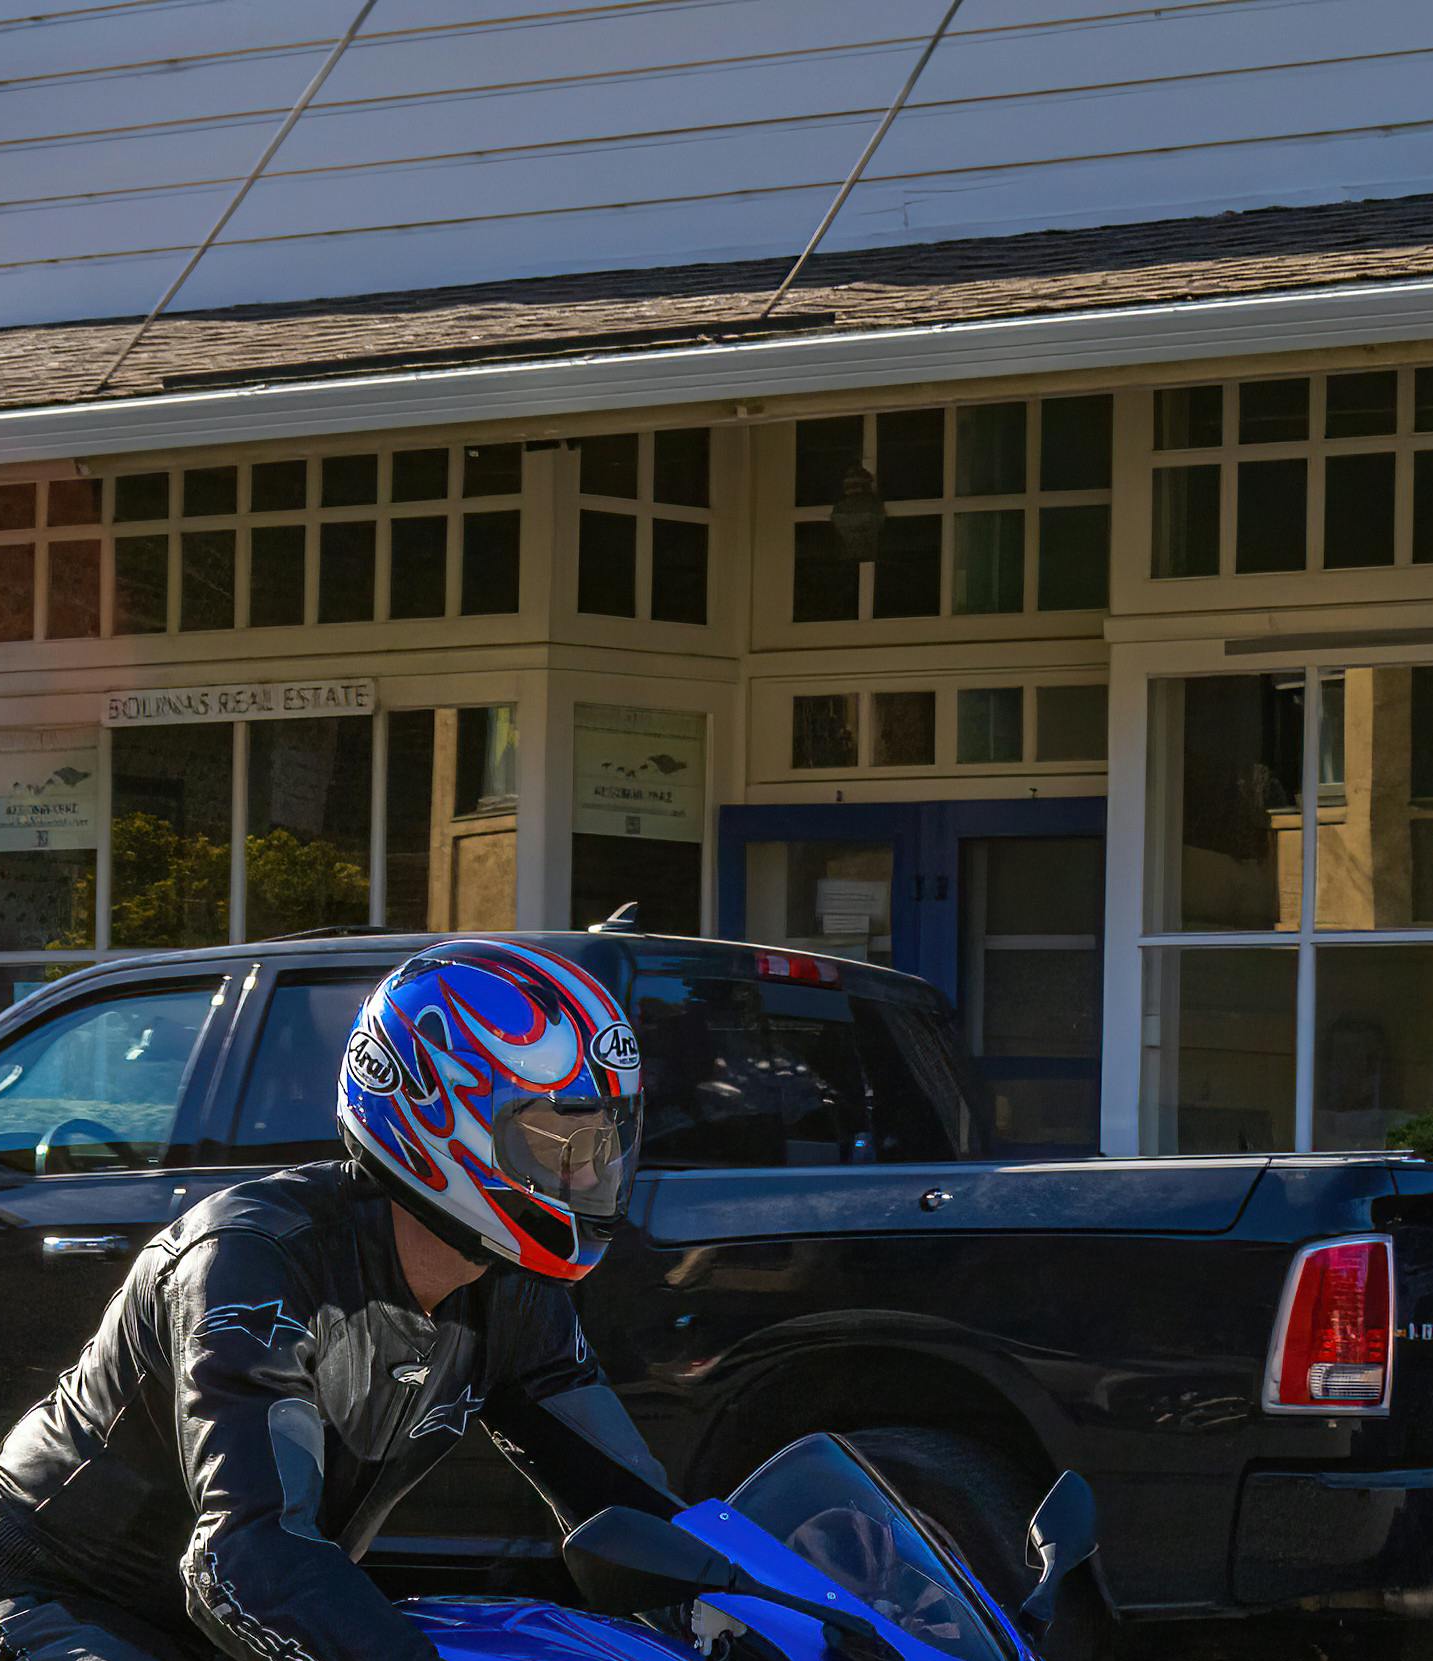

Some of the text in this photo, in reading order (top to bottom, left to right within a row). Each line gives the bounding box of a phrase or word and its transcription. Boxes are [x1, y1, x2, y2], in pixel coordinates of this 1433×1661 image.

[217, 688, 274, 714] REAL
[283, 683, 369, 711] ESTATE
[349, 1037, 394, 1085] Arai
